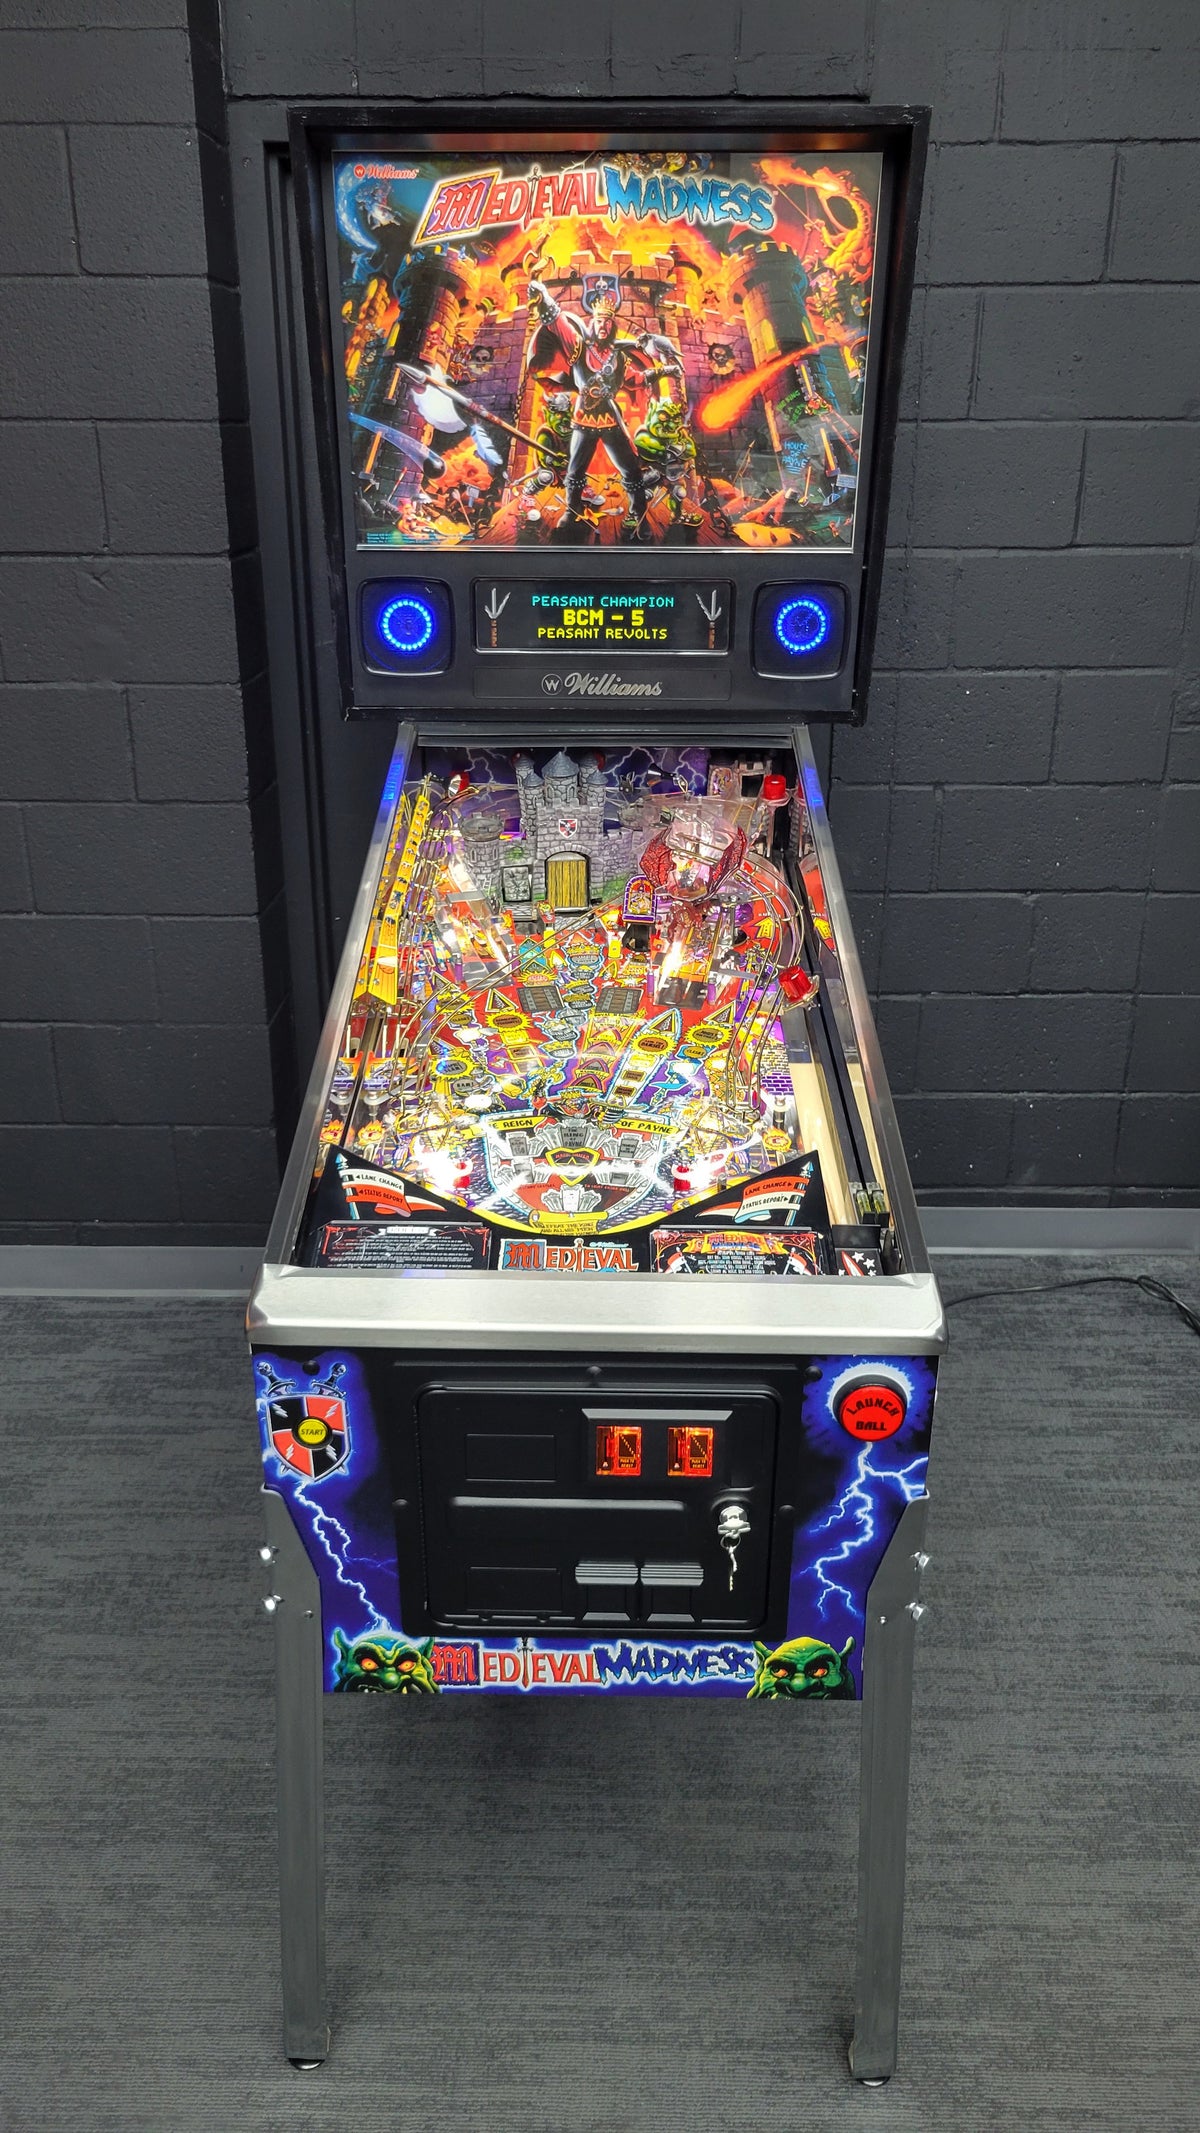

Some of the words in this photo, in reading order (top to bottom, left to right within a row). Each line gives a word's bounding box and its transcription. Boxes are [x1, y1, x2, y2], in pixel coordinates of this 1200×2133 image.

[422, 166, 609, 237] MEDIEVAL
[603, 166, 774, 231] MADNESS
[531, 595, 594, 607] PEASANT
[600, 596, 674, 608] CHAMPION
[563, 609, 604, 626] BCM
[631, 609, 645, 627] 5
[537, 627, 600, 639] PEASANT
[605, 628, 668, 640] REVOLTS
[564, 672, 662, 696] Williams
[503, 1119, 533, 1129] REIGN
[621, 1120, 634, 1128] OF
[637, 1123, 673, 1134] PAYNE
[361, 1173, 377, 1182] LANE
[379, 1178, 402, 1190] CHANGE
[745, 1186, 761, 1196] LANE
[762, 1181, 787, 1191] CHANGE
[363, 1189, 382, 1199] STATUS
[382, 1191, 403, 1204] REPORT
[742, 1200, 762, 1211] STATUS
[761, 1195, 785, 1205] REPORT
[504, 1241, 638, 1271] MEDIEVAL
[846, 1397, 900, 1416] LAUNCH
[856, 1421, 887, 1431] BALL
[430, 1639, 601, 1686] MEDIEVAL
[593, 1642, 755, 1685] MADNESS
